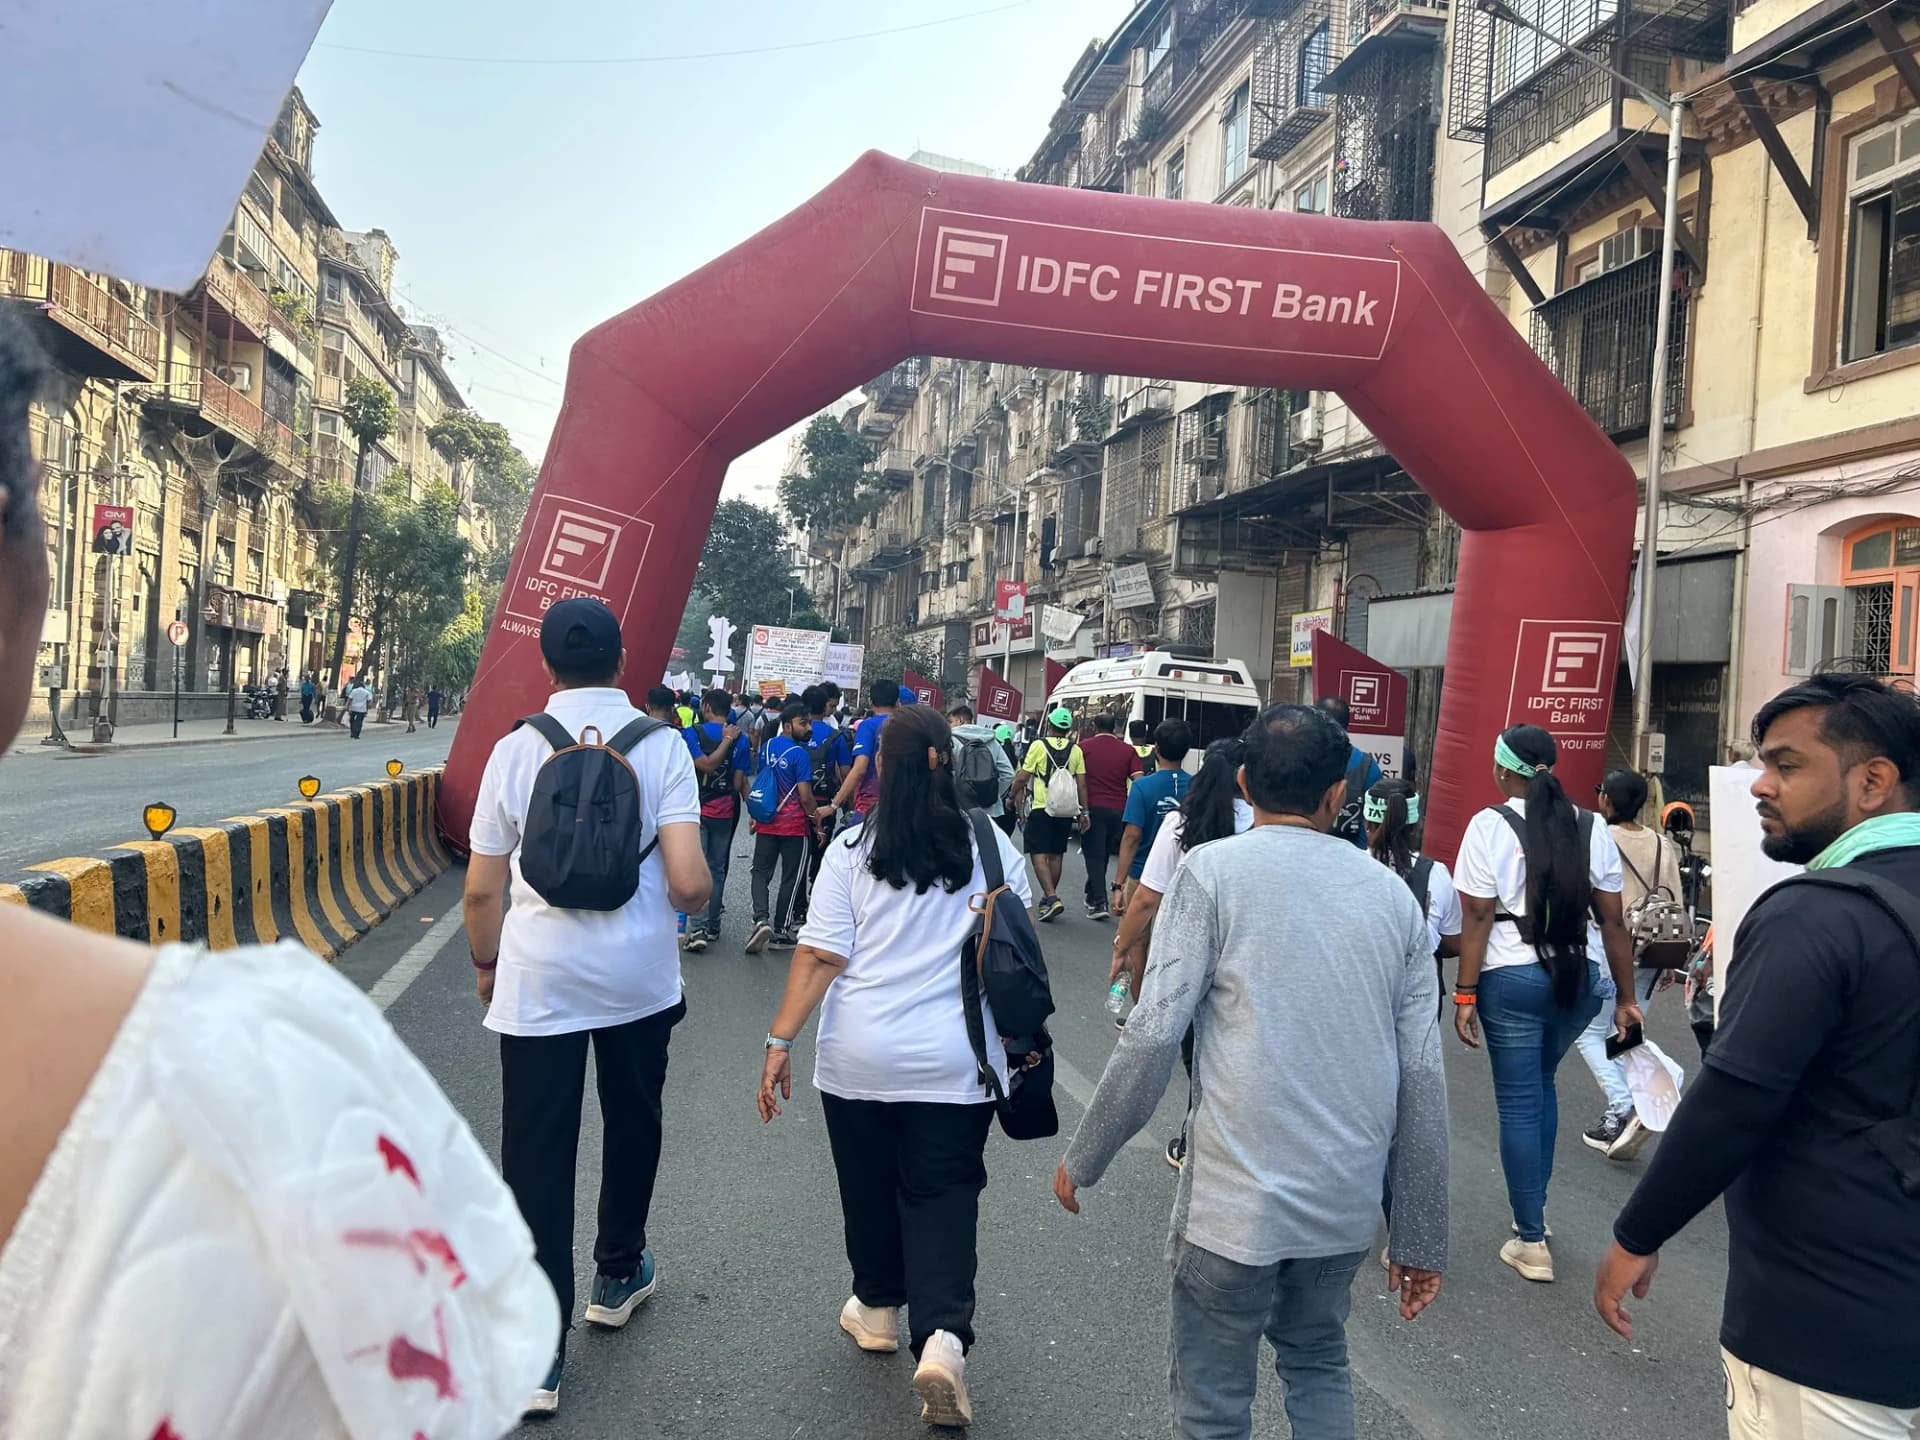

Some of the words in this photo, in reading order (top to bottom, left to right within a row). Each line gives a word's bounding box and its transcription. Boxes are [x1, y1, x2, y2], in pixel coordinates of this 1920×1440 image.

[1016, 255, 1120, 302] IDFC
[1134, 270, 1262, 316] FIRST
[1272, 283, 1381, 326] Bank
[525, 576, 558, 596] IDFC
[500, 619, 541, 638] ALWAYS
[1527, 697, 1565, 709] IDFC
[1569, 698, 1604, 710] FIRST
[1362, 707, 1381, 715] FIRST
[1550, 711, 1586, 723] Bank
[1560, 739, 1583, 750] YOU
[1585, 740, 1606, 749] FIRST
